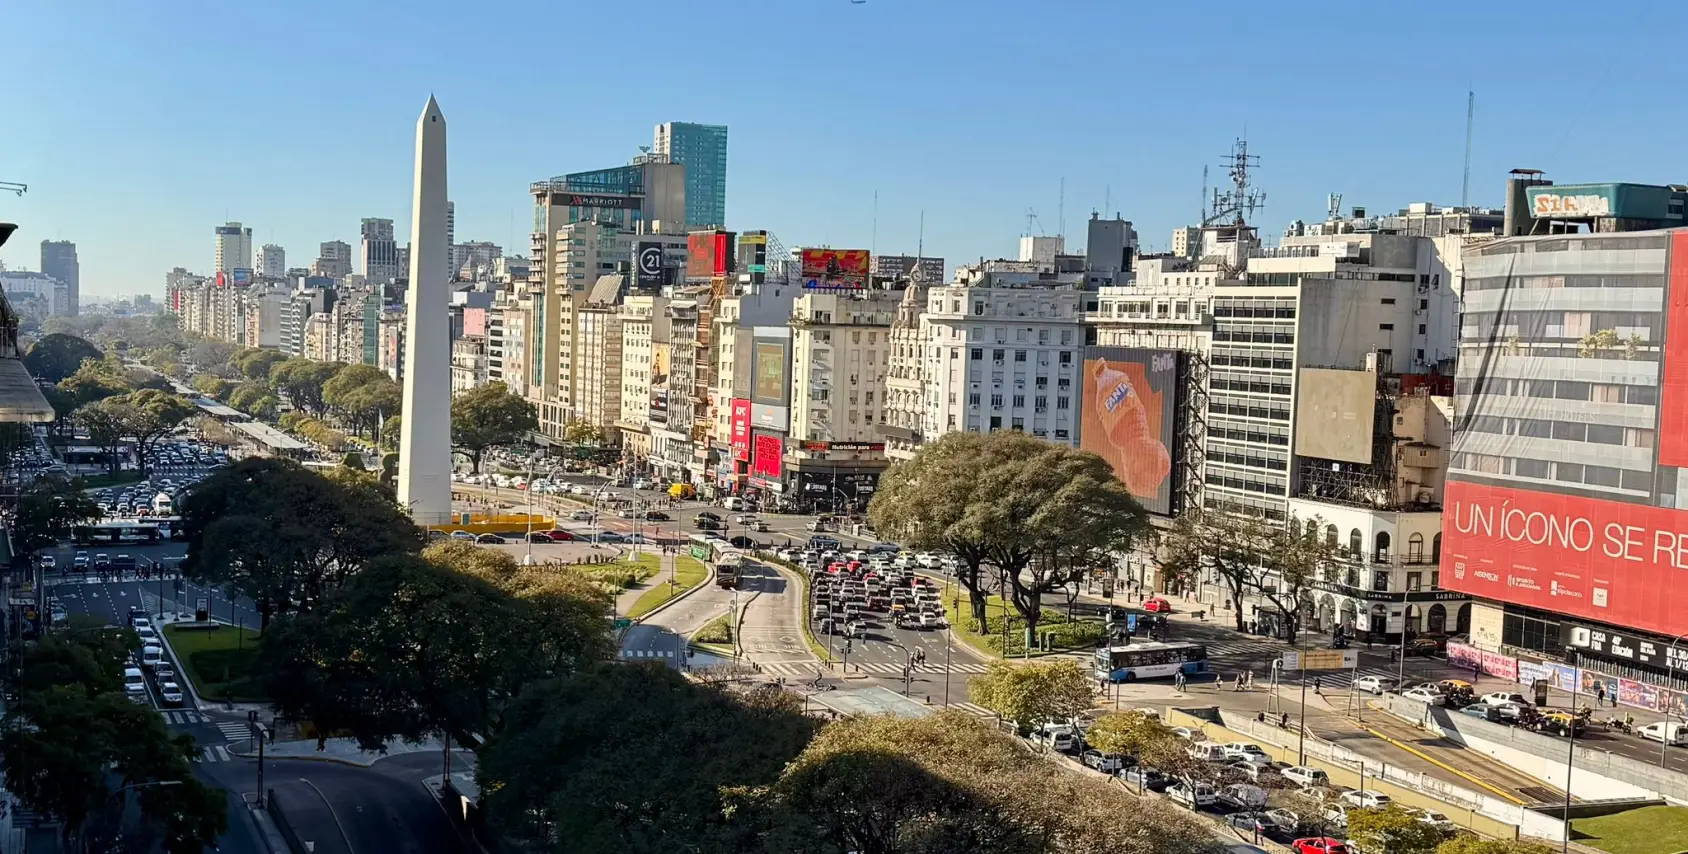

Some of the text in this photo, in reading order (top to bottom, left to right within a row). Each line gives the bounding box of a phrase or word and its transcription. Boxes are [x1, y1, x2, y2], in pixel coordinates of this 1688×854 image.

[1455, 501, 1494, 537] UN
[1500, 500, 1594, 552] ÍCONO
[1602, 522, 1645, 562] SE
[1591, 631, 1606, 643] CASA
